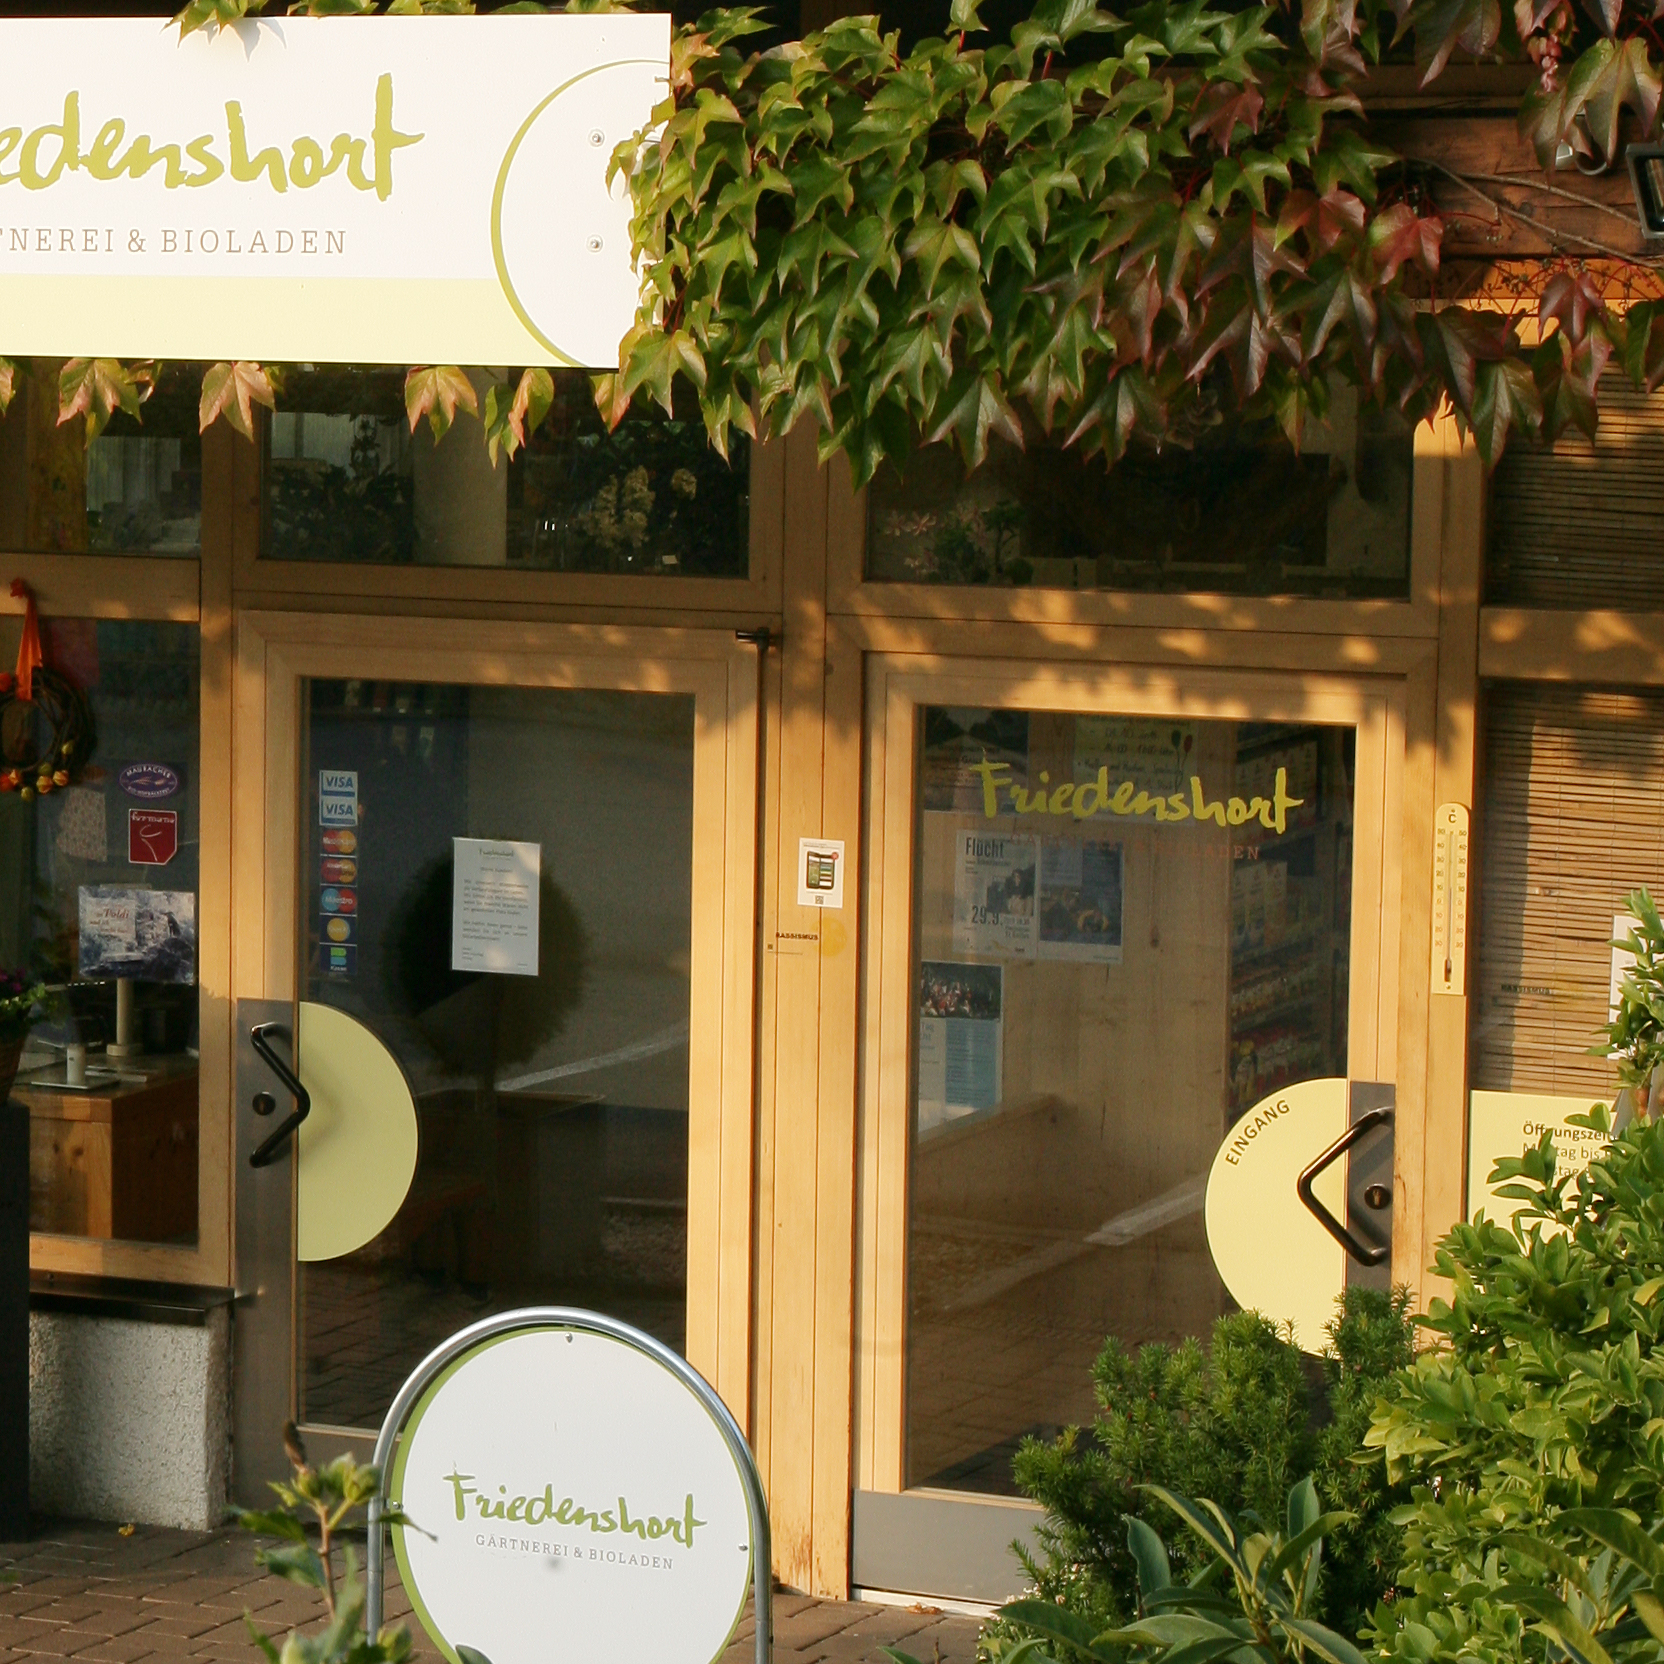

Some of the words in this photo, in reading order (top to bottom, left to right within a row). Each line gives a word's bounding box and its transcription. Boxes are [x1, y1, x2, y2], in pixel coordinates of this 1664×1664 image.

[127, 229, 147, 253] &
[161, 229, 347, 254] BIOLADEN
[326, 777, 353, 788] VISA
[970, 747, 1304, 834] Friedenshort
[326, 804, 353, 816] VISA
[1225, 1099, 1290, 1166] EINGANG
[1581, 1143, 1599, 1159] bis
[442, 1460, 708, 1548] Friedenshort
[475, 1533, 569, 1557] GÄRTNEREI
[573, 1546, 584, 1558] &
[588, 1549, 674, 1570] BIOLADEN
